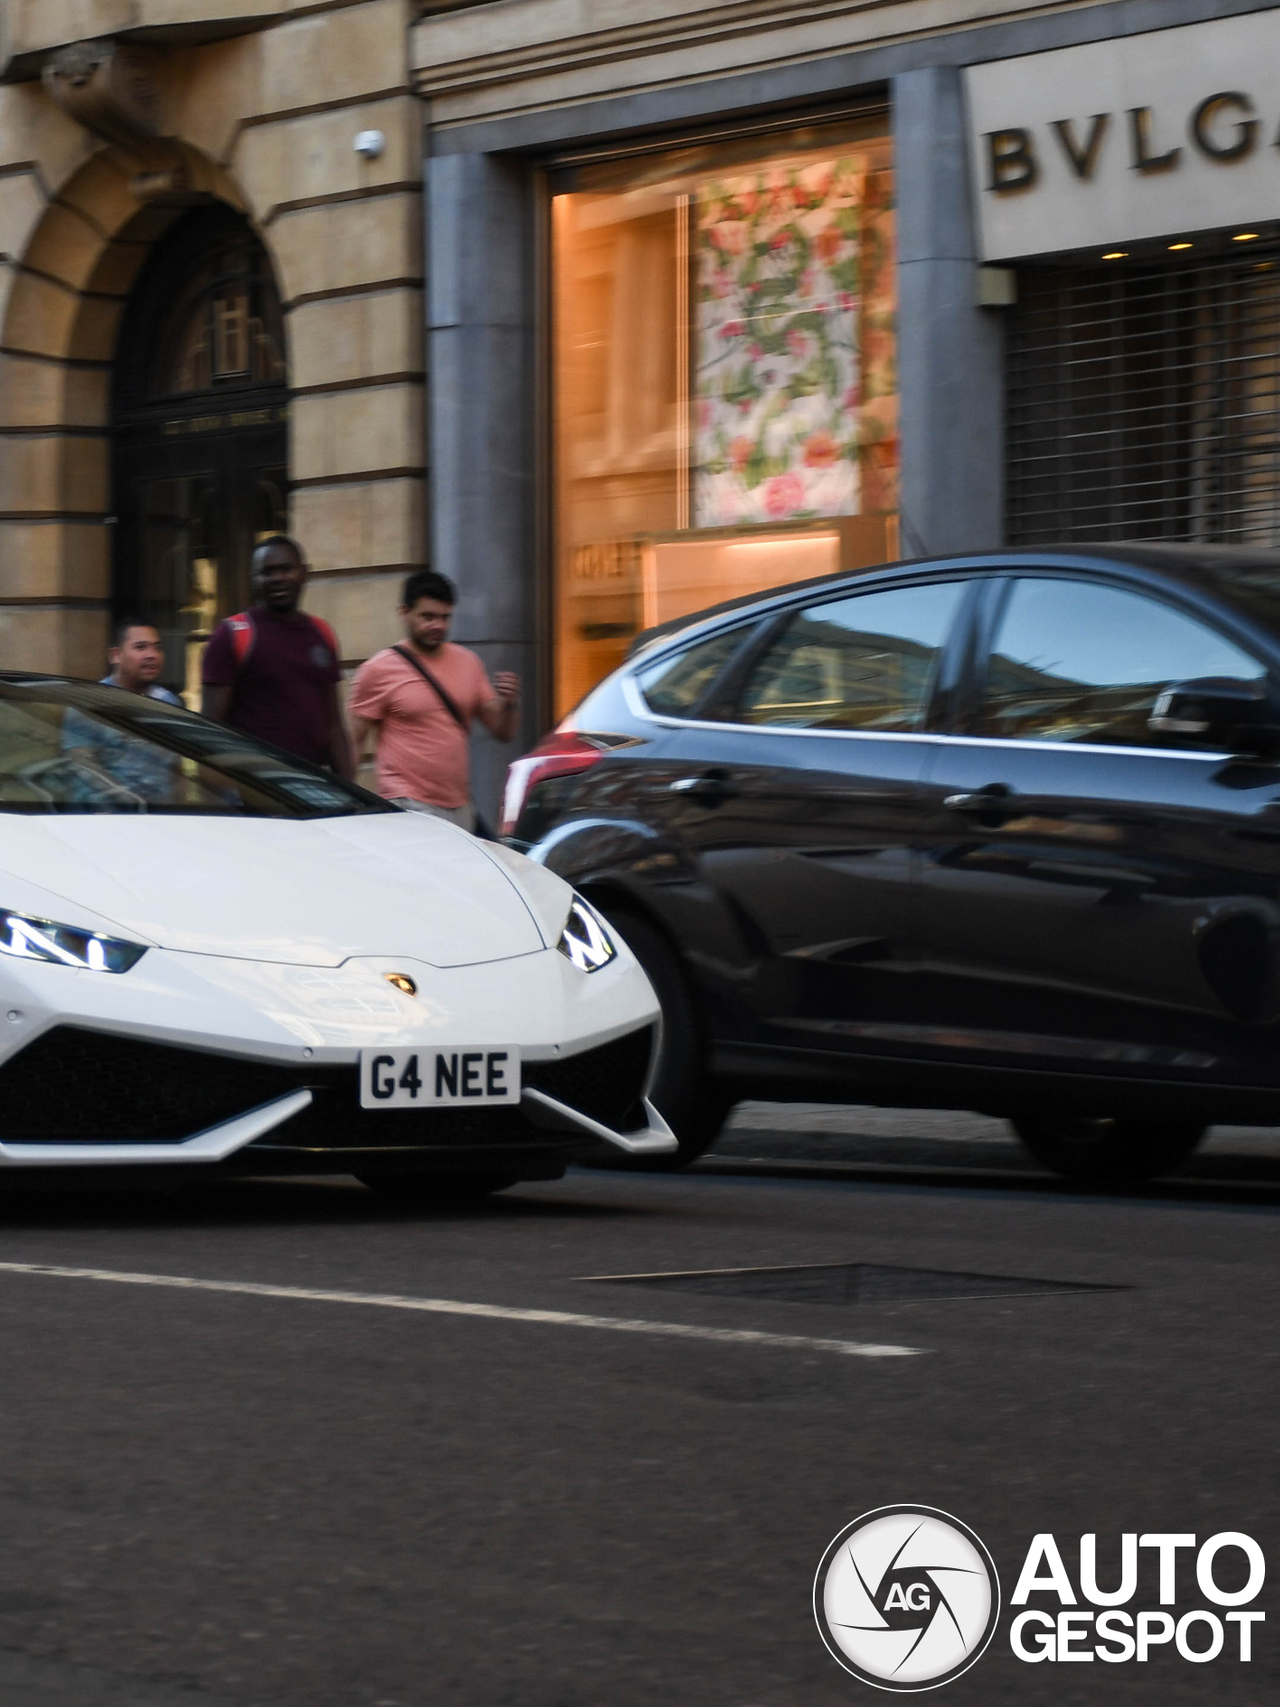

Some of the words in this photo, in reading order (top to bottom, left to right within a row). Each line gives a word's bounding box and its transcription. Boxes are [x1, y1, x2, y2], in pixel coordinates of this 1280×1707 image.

[979, 90, 1280, 194] BVLG
[371, 1054, 422, 1099] G4
[435, 1052, 508, 1097] NEE
